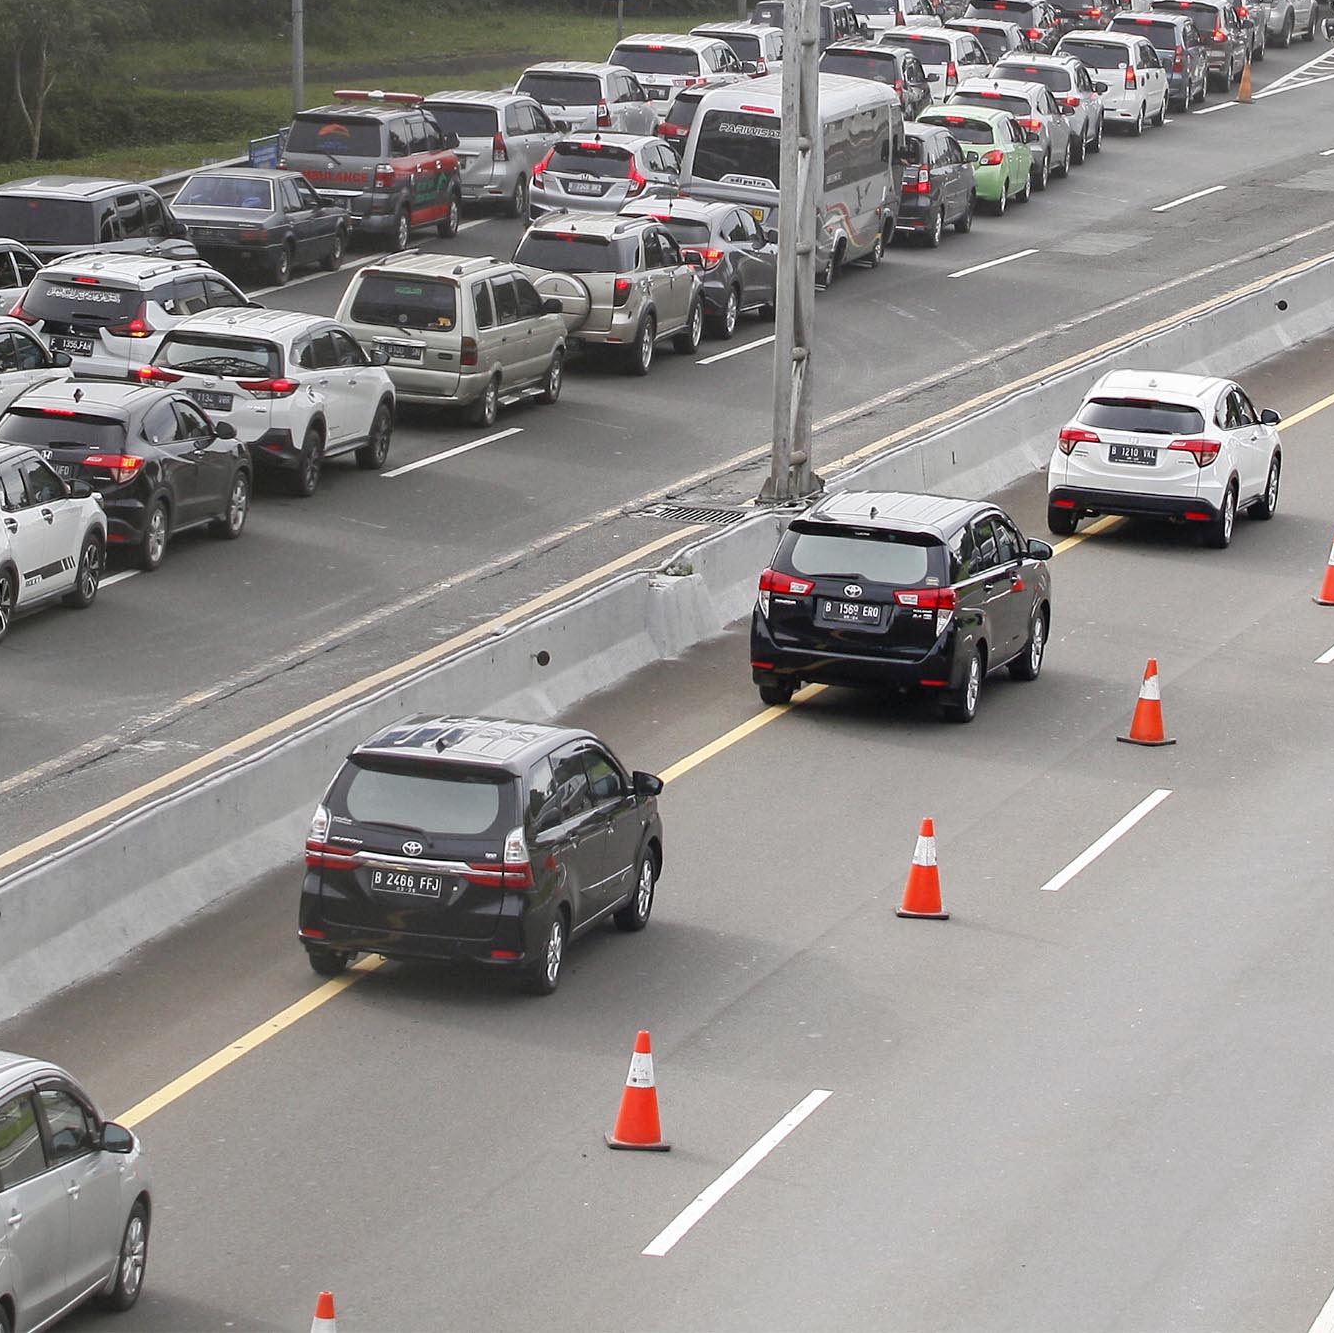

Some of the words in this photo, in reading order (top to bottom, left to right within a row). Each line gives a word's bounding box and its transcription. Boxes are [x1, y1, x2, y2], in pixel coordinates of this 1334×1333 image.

[719, 122, 781, 138] PARIWISAT
[1111, 446, 1117, 455] B
[1122, 447, 1138, 457] 1210
[825, 602, 831, 612] B
[374, 871, 381, 884] B
[387, 873, 414, 887] 2466
[419, 877, 439, 891] FFJ
